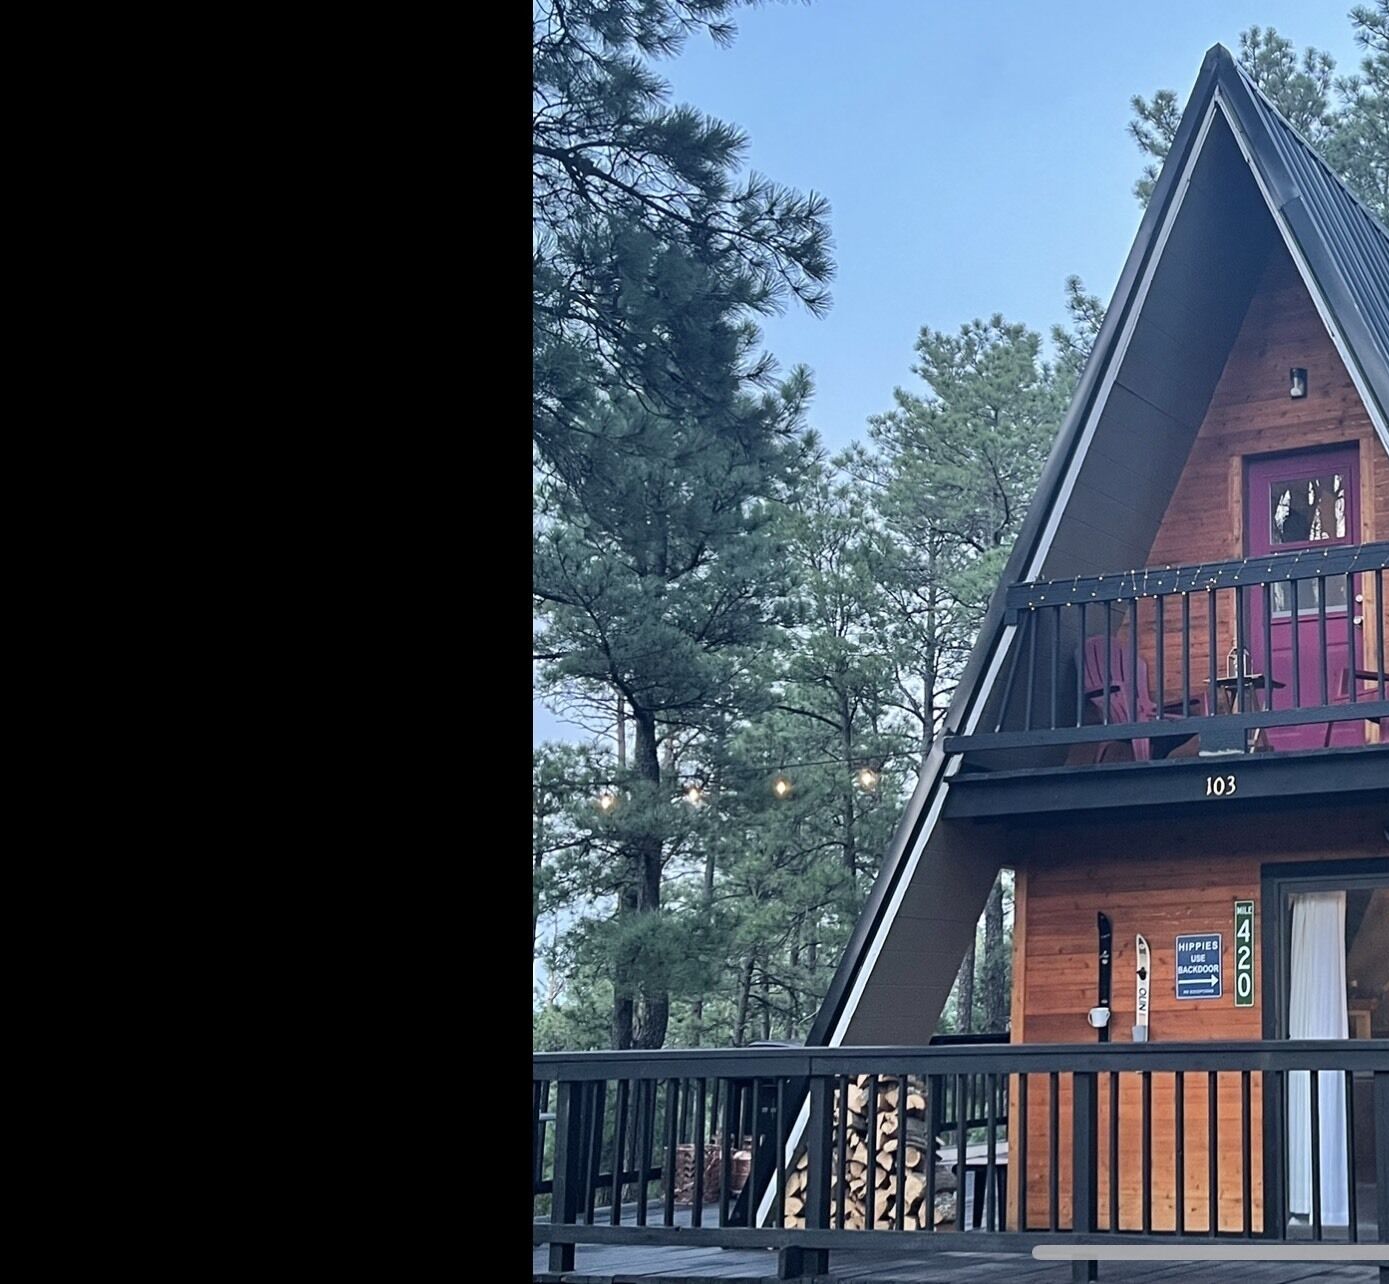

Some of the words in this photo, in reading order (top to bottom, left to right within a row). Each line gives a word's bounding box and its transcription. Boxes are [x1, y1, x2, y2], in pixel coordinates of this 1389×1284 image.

[1206, 775, 1236, 796] 103
[1237, 906, 1252, 915] MILE
[1178, 941, 1218, 952] HIPPIES
[1190, 954, 1206, 963] USE
[1237, 919, 1251, 998] 420
[1178, 964, 1219, 974] BACKDOOR
